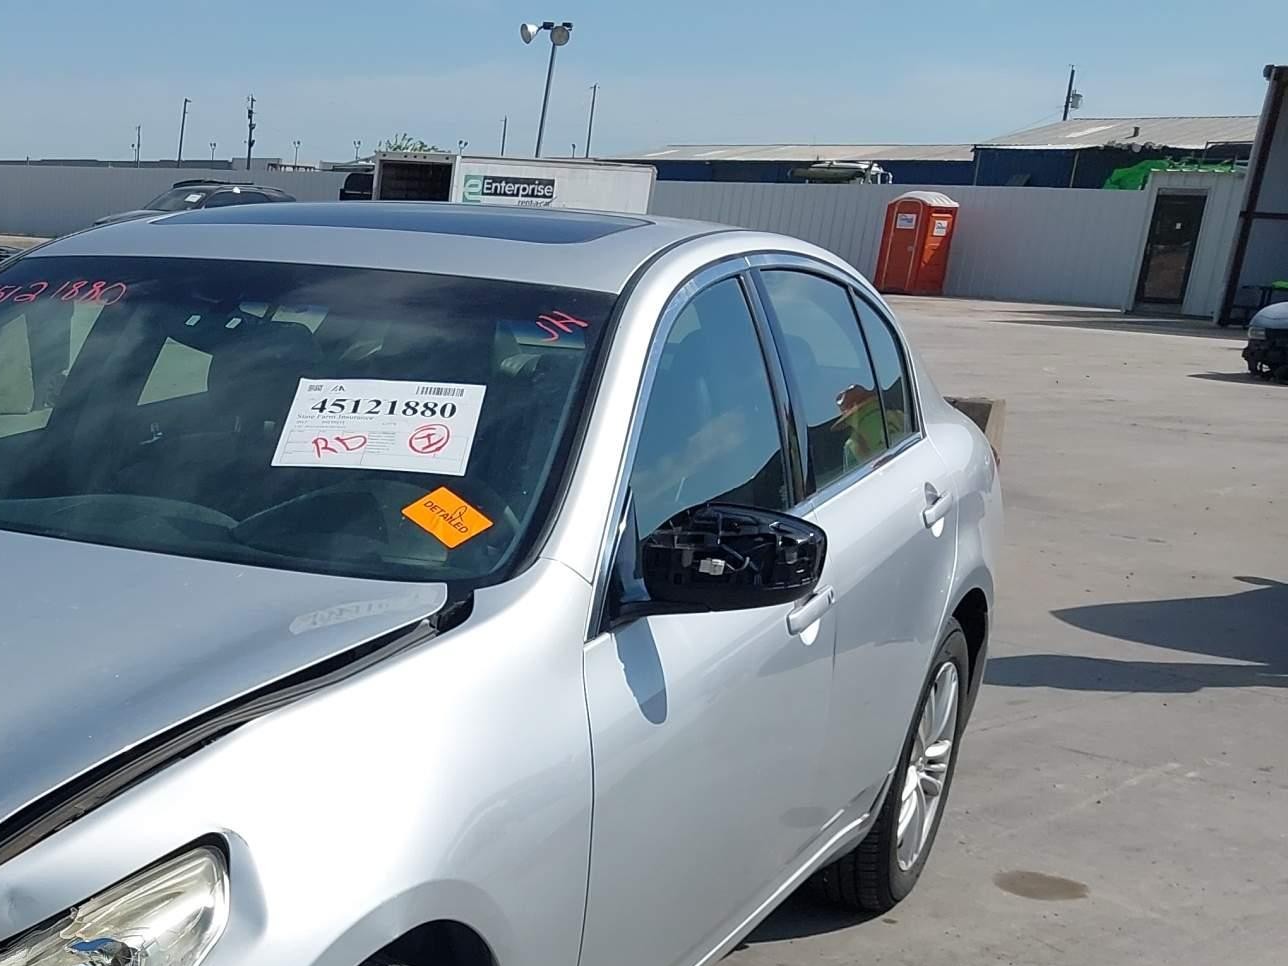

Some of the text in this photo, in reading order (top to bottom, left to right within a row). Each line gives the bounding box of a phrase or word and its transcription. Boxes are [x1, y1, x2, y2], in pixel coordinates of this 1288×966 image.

[483, 179, 553, 198] Enterprise
[310, 398, 457, 418] 45121880
[423, 500, 469, 534] DETAILED
